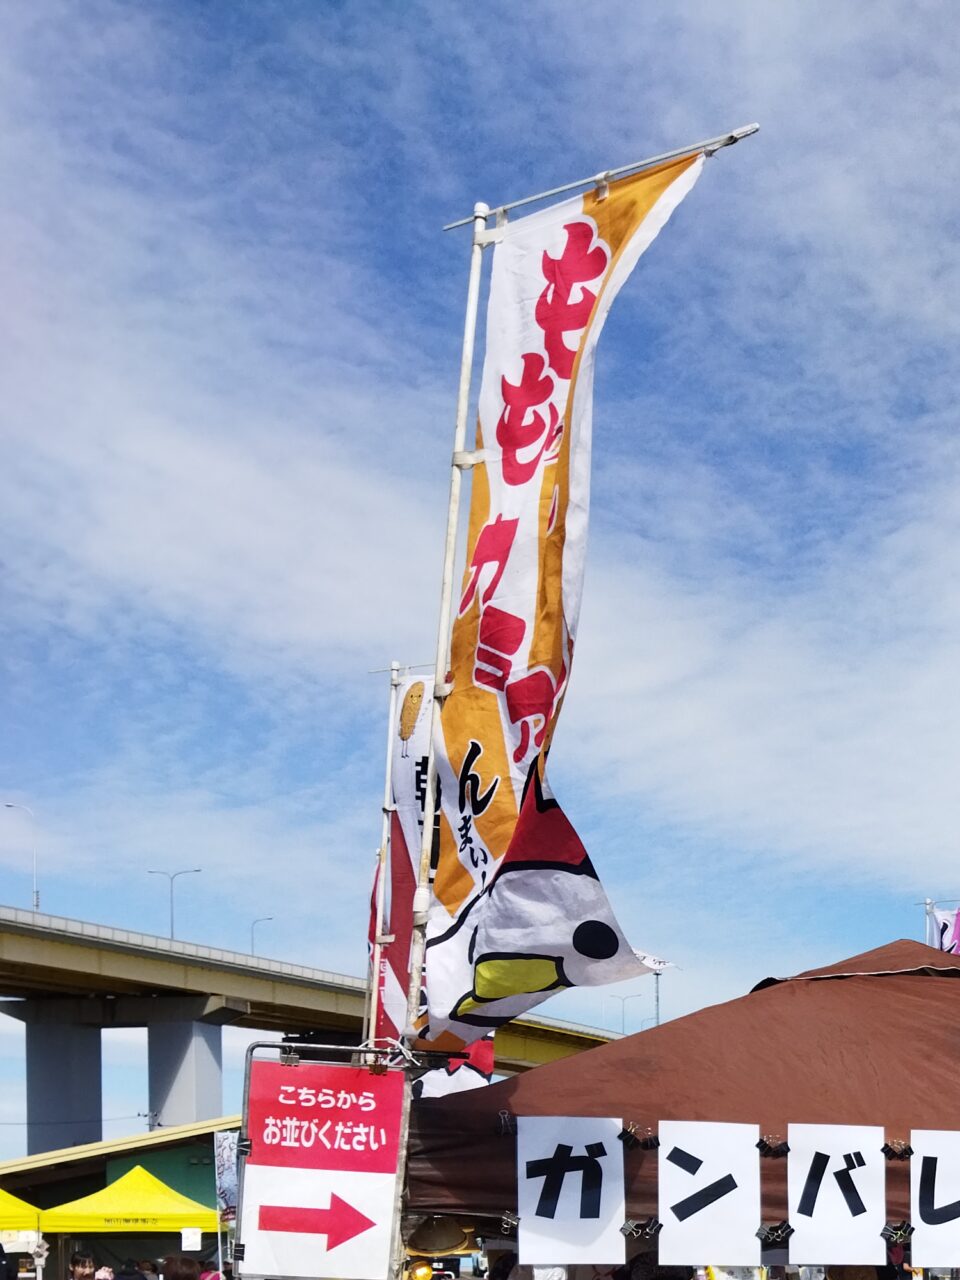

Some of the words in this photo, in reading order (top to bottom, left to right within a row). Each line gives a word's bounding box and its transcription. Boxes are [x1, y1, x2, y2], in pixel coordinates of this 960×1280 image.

[278, 1086, 376, 1111] こちらから
[263, 1116, 387, 1151] お並びください
